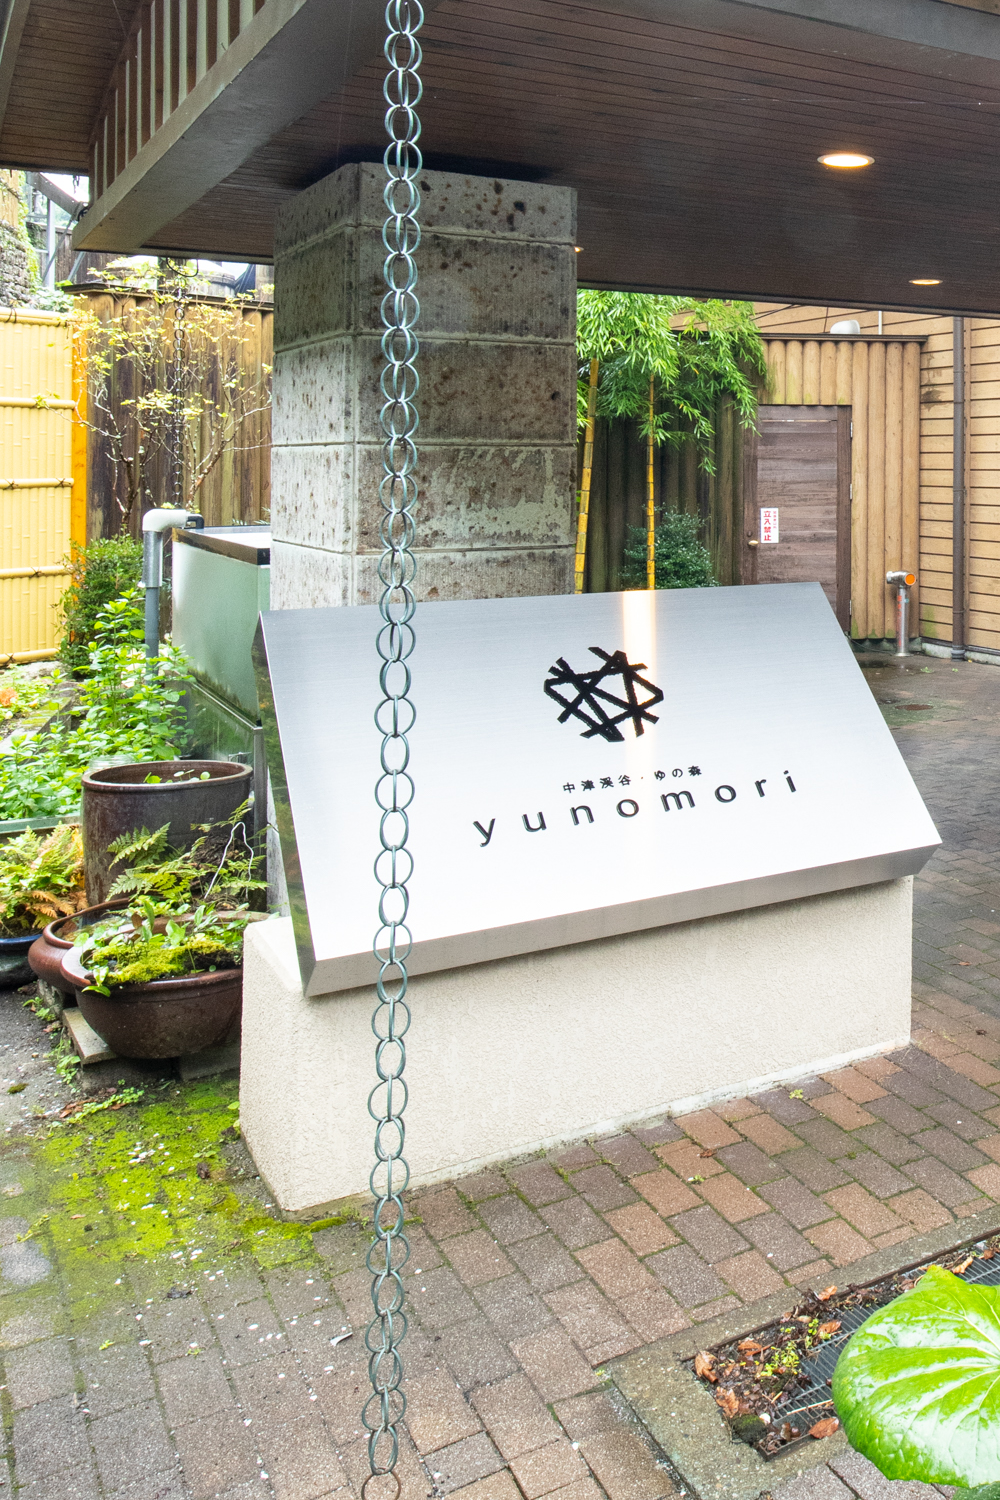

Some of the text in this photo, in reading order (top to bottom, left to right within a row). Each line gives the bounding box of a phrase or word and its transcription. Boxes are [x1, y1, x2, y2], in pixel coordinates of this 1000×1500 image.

[763, 510, 772, 541] 立入禁止
[473, 770, 797, 847] yunomori
